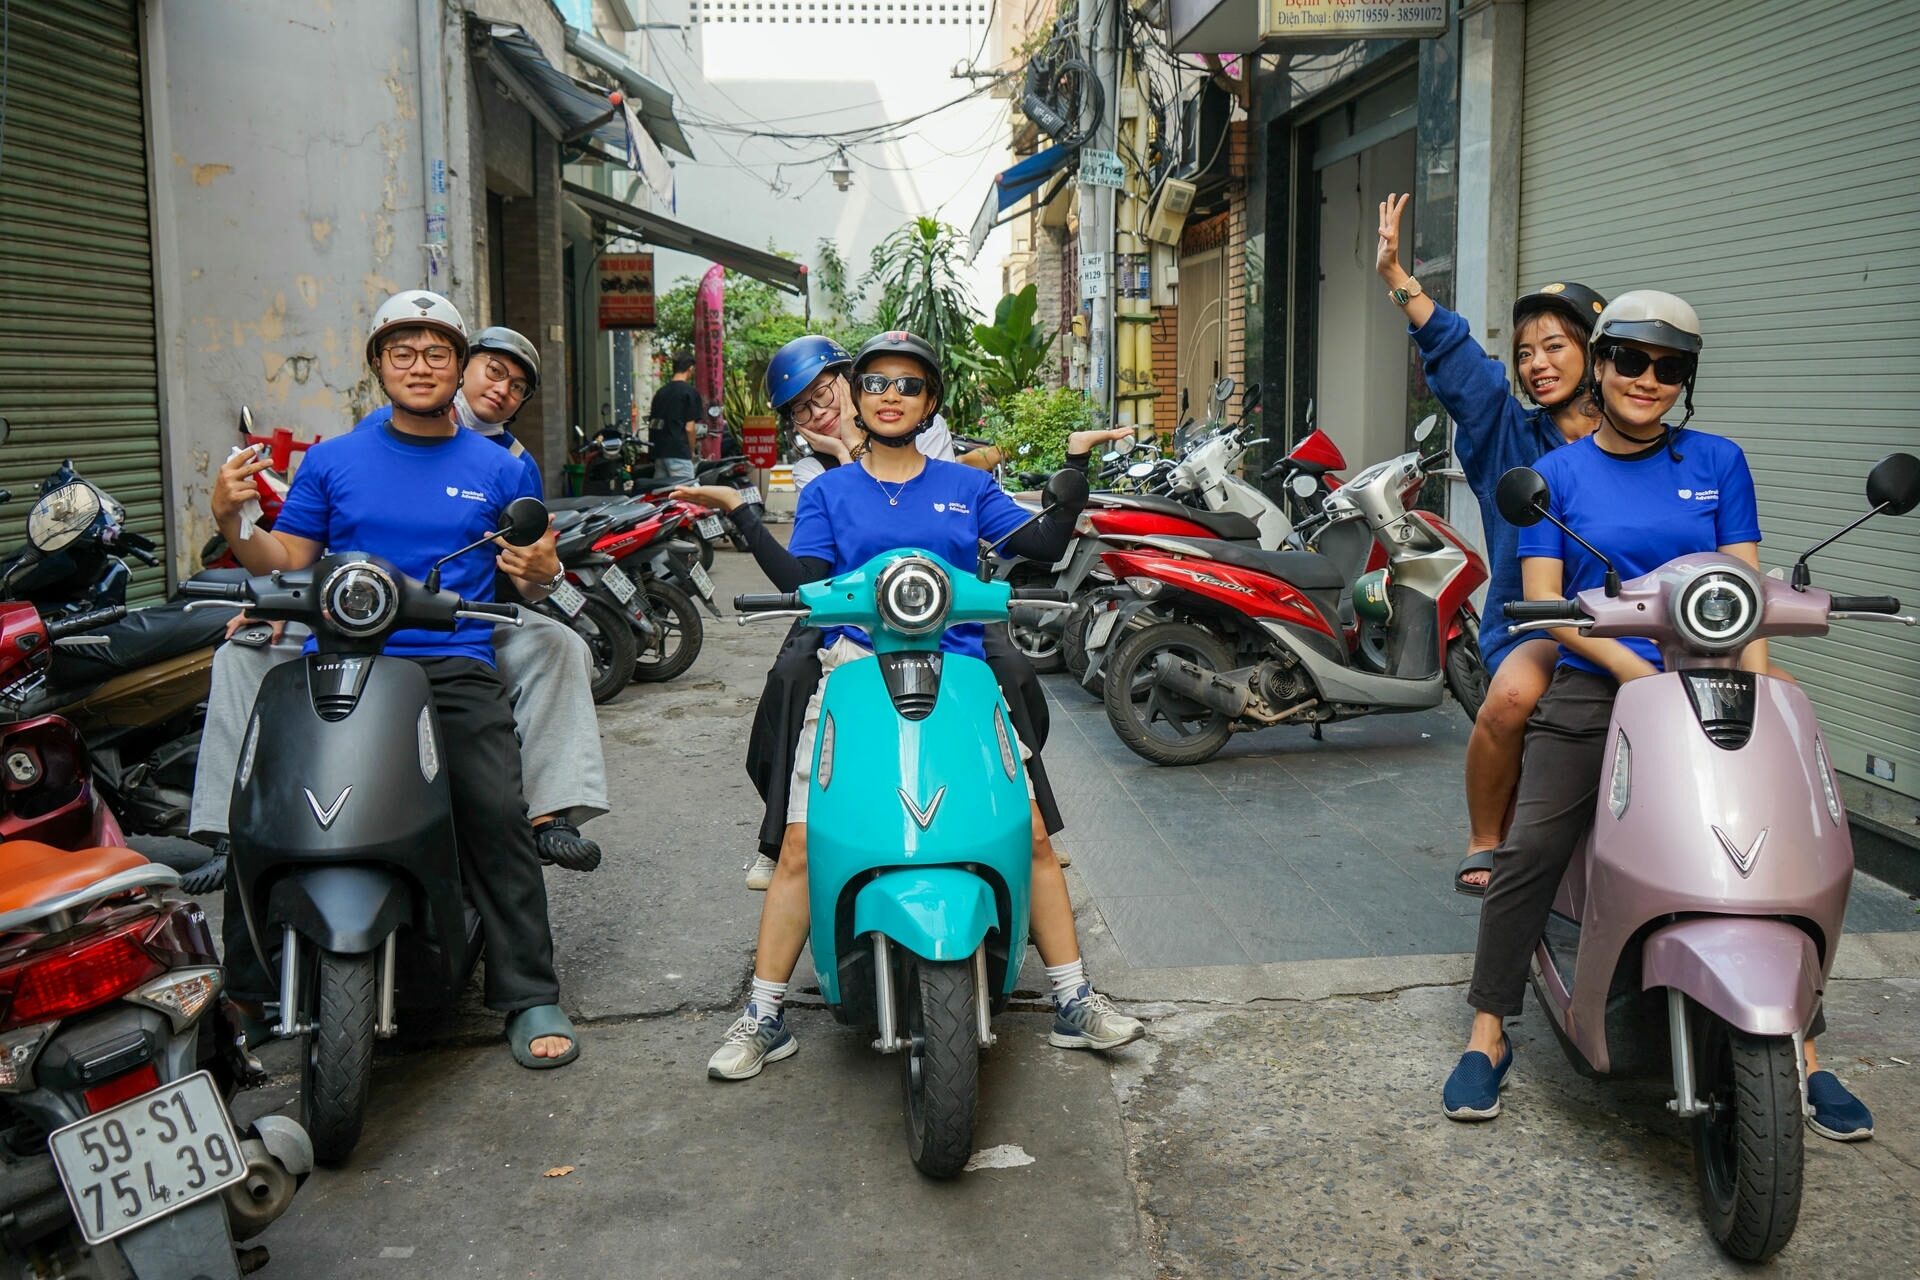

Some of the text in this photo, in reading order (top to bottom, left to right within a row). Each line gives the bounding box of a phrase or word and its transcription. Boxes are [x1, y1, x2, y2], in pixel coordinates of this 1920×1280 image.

[1278, 11, 1299, 27] Điện
[1301, 10, 1327, 26] Thoại
[1333, 8, 1389, 24] 0939719559
[1397, 7, 1443, 22] 38591072
[1084, 270, 1101, 280] H129
[1191, 572, 1257, 598] VISION
[316, 661, 362, 671] VINFAST
[890, 661, 935, 670] VINFAST
[1695, 682, 1748, 691] VINFAST
[78, 1090, 198, 1173] 59-S1
[81, 1133, 234, 1232] 754.39
